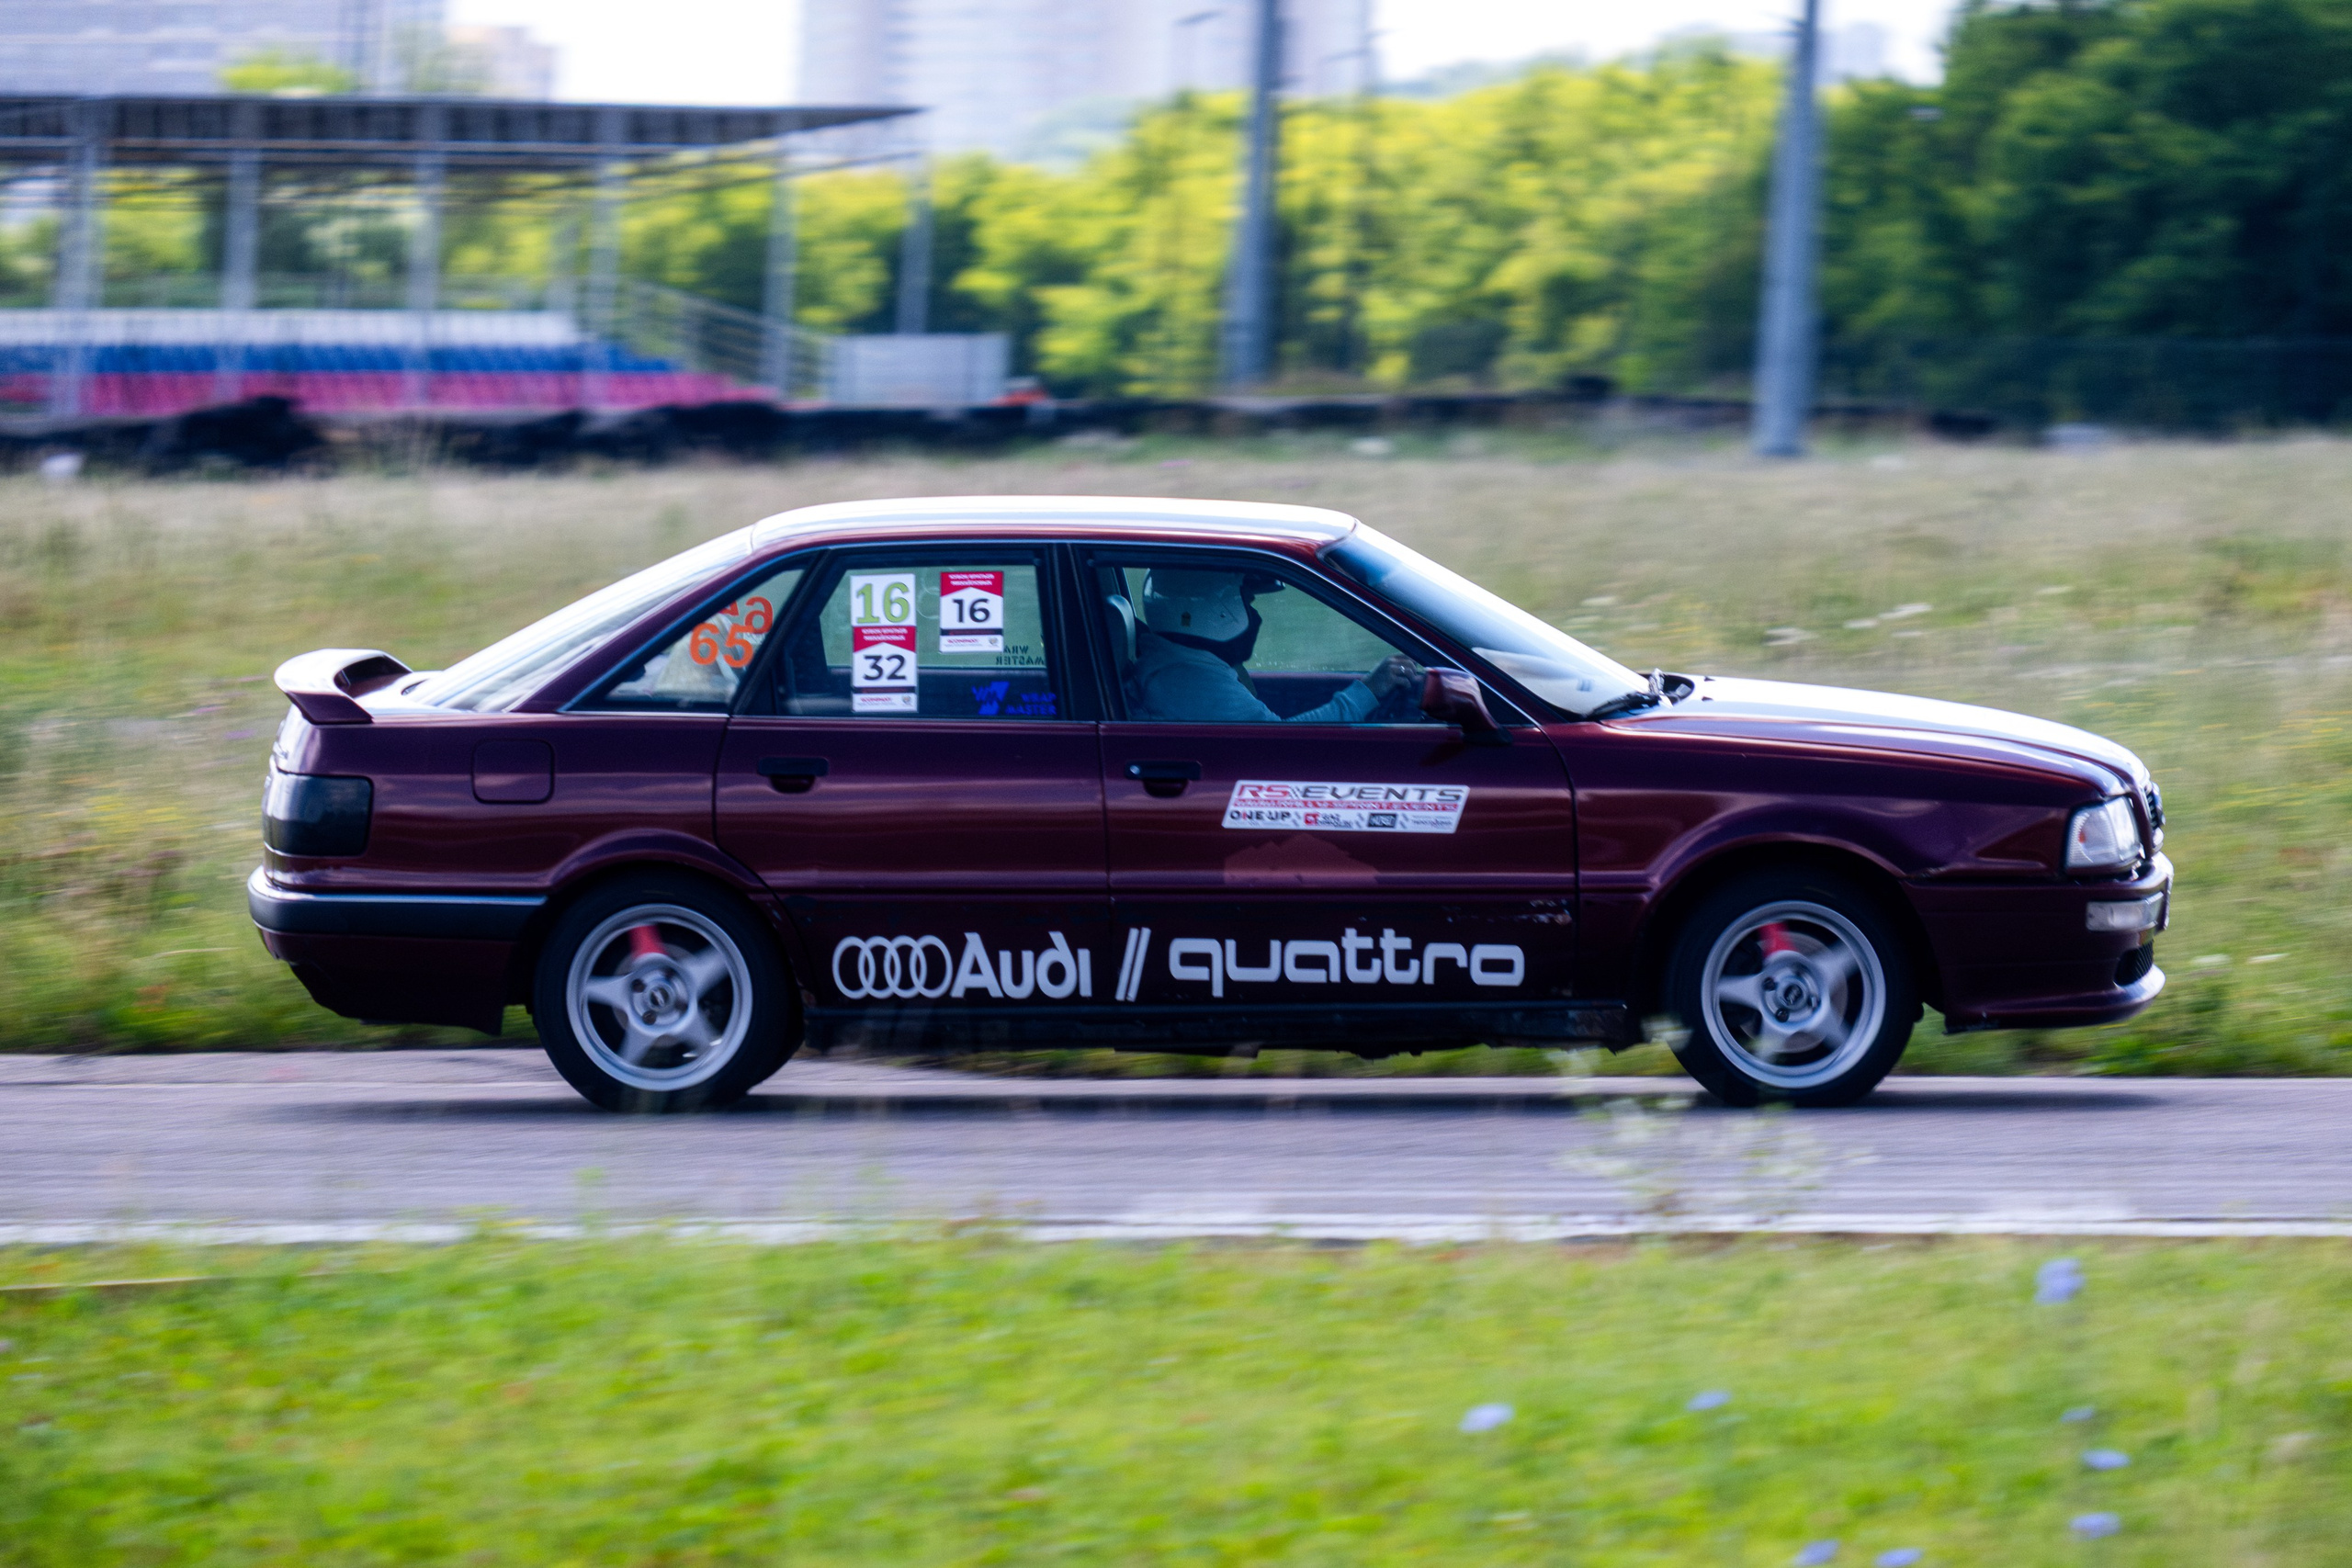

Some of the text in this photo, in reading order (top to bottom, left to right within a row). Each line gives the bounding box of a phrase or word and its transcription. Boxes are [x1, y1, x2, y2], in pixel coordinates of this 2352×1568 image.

[855, 582, 910, 624] 16
[952, 598, 990, 623] 16
[689, 622, 754, 668] 65
[864, 654, 907, 681] 32
[1302, 785, 1464, 802] EVENTS
[949, 931, 1092, 999] Audi
[1169, 928, 1525, 998] quattro
